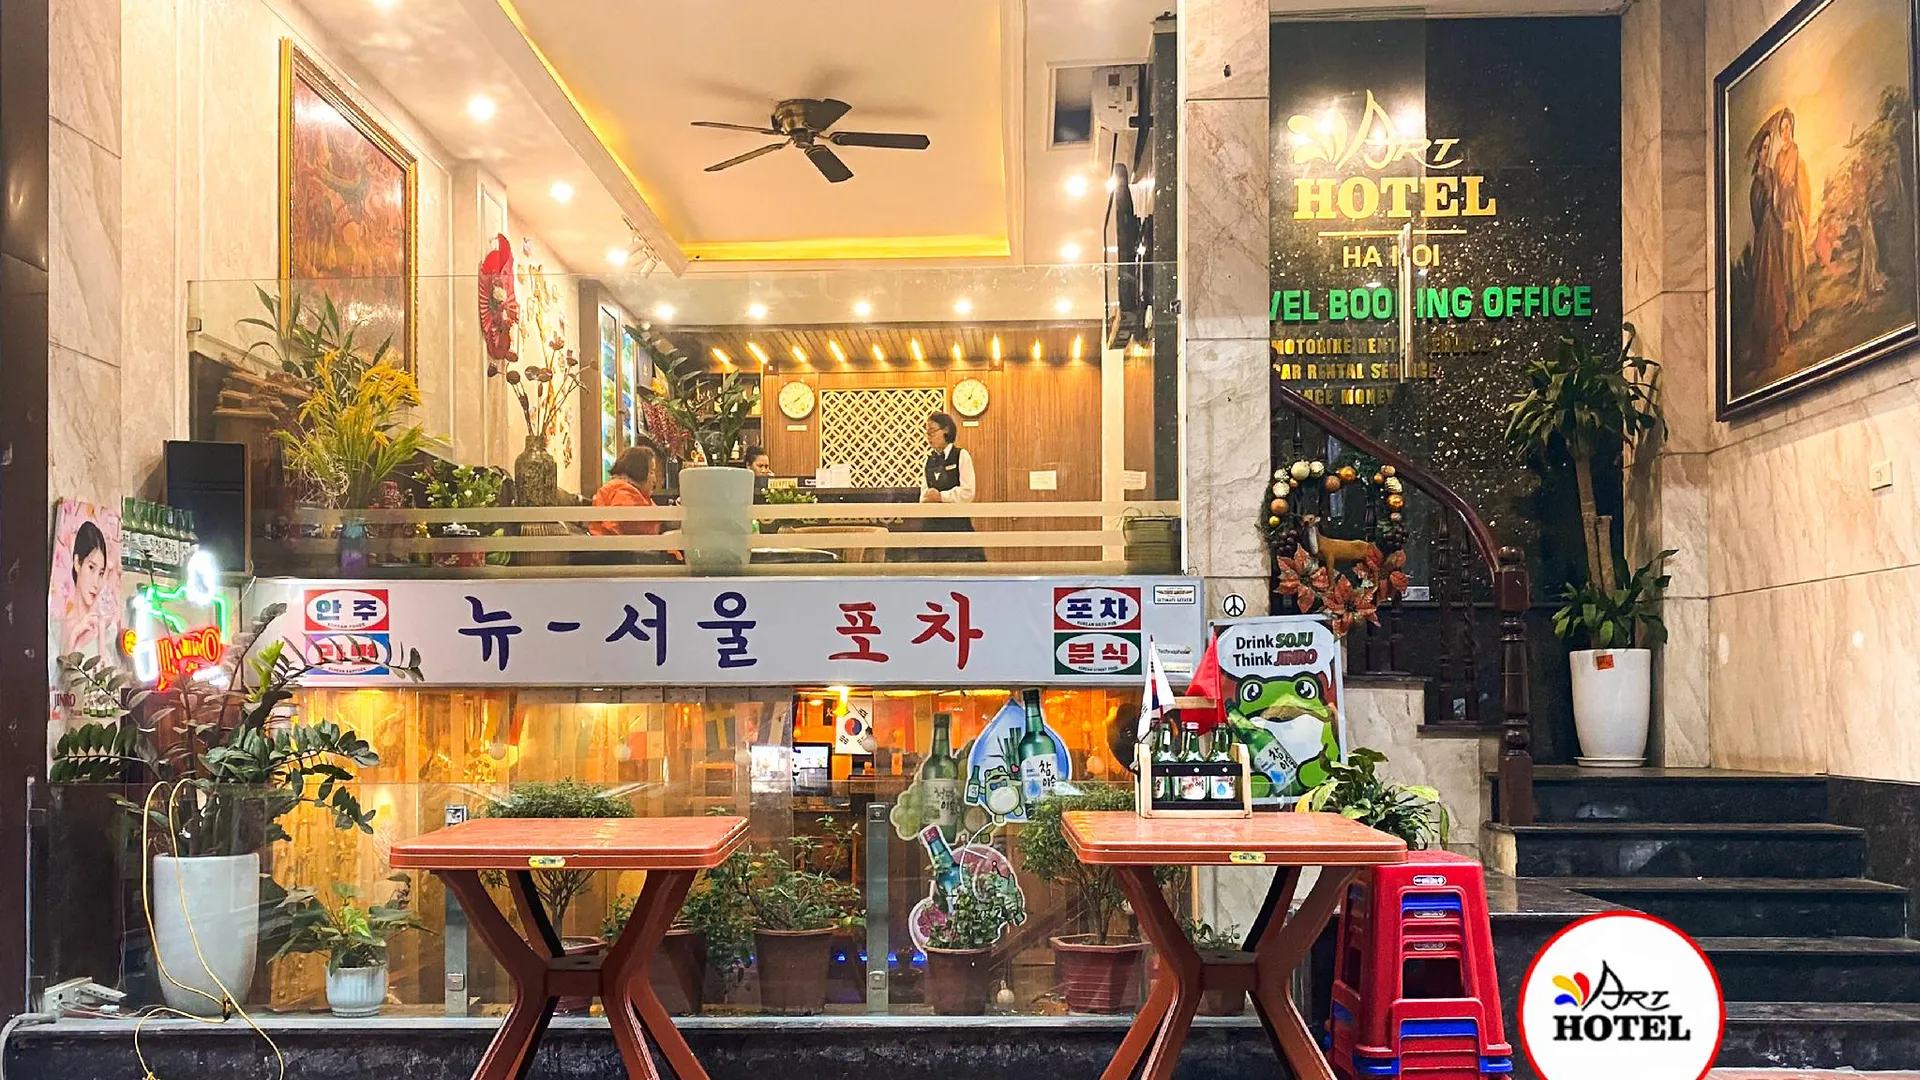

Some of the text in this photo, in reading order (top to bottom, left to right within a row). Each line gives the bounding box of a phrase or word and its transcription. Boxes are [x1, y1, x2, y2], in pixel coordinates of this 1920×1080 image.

[1294, 176, 1496, 220] HOTEL
[1343, 245, 1383, 268] HA
[1329, 287, 1472, 319] BOOING
[1483, 286, 1592, 318] OFFICE
[1308, 363, 1364, 380] RENTAL
[1371, 363, 1438, 380] SERICE
[316, 600, 377, 621] 안주
[1067, 597, 1128, 619] 포차
[828, 591, 983, 670] 포차
[1236, 632, 1314, 649] Drink SOJU
[1068, 643, 1128, 664] 분식
[1233, 649, 1318, 667] Think JINRO
